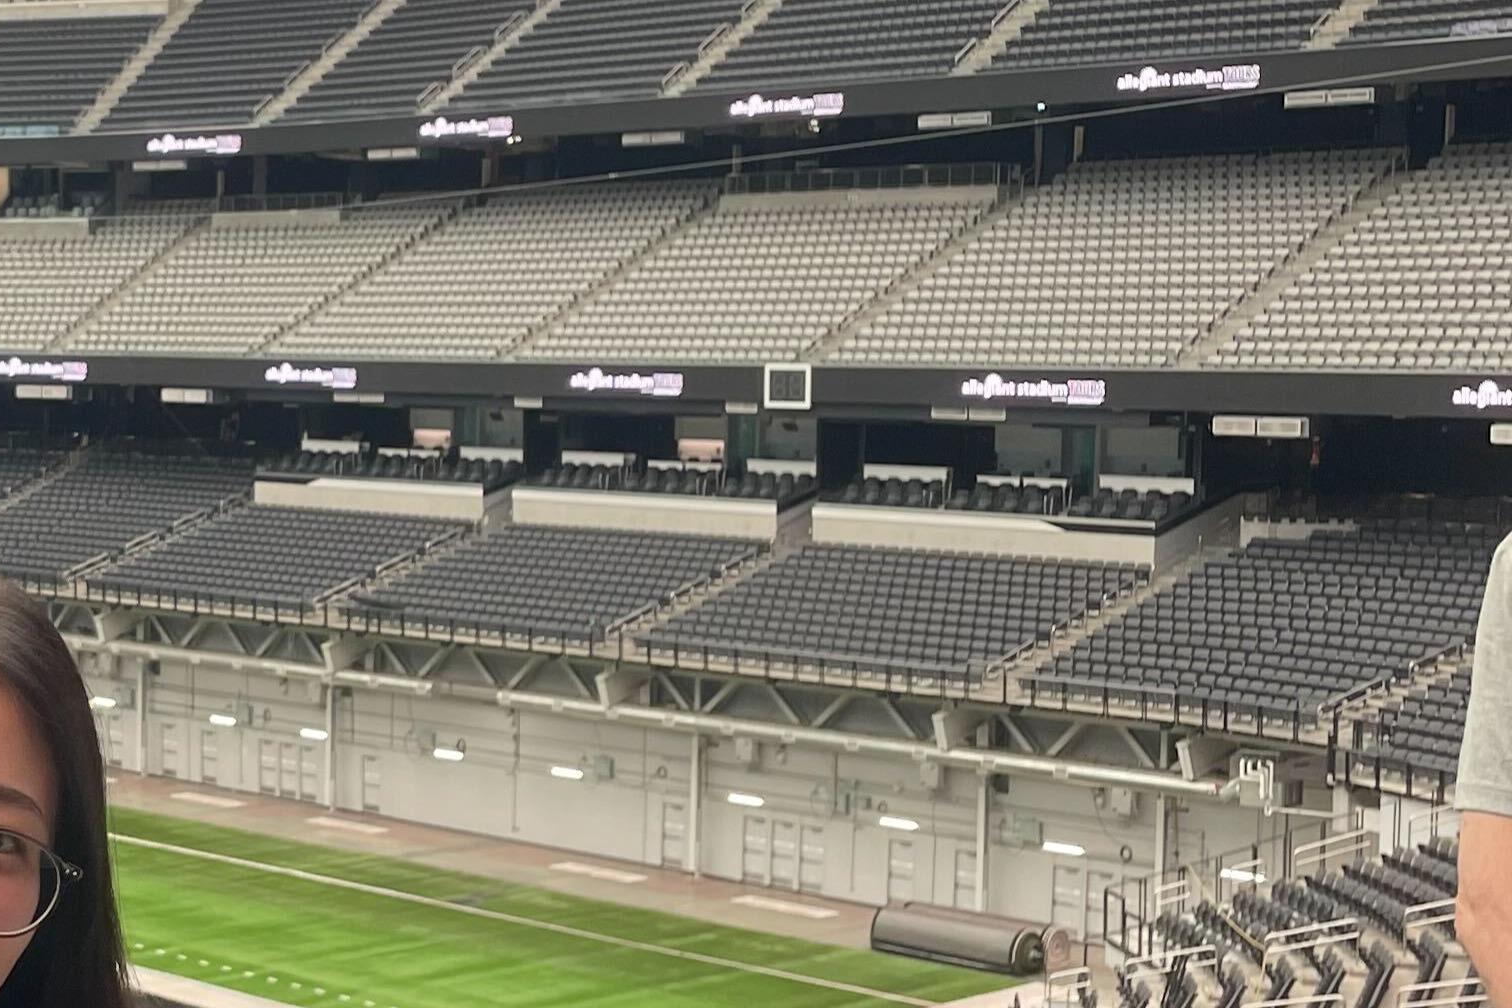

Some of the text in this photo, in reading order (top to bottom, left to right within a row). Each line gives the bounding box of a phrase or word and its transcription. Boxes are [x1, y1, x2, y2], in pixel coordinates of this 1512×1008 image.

[1117, 66, 1170, 91] allegiant
[1171, 69, 1223, 87] stadium
[961, 373, 1015, 400] allegiant
[1016, 379, 1068, 398] stadium
